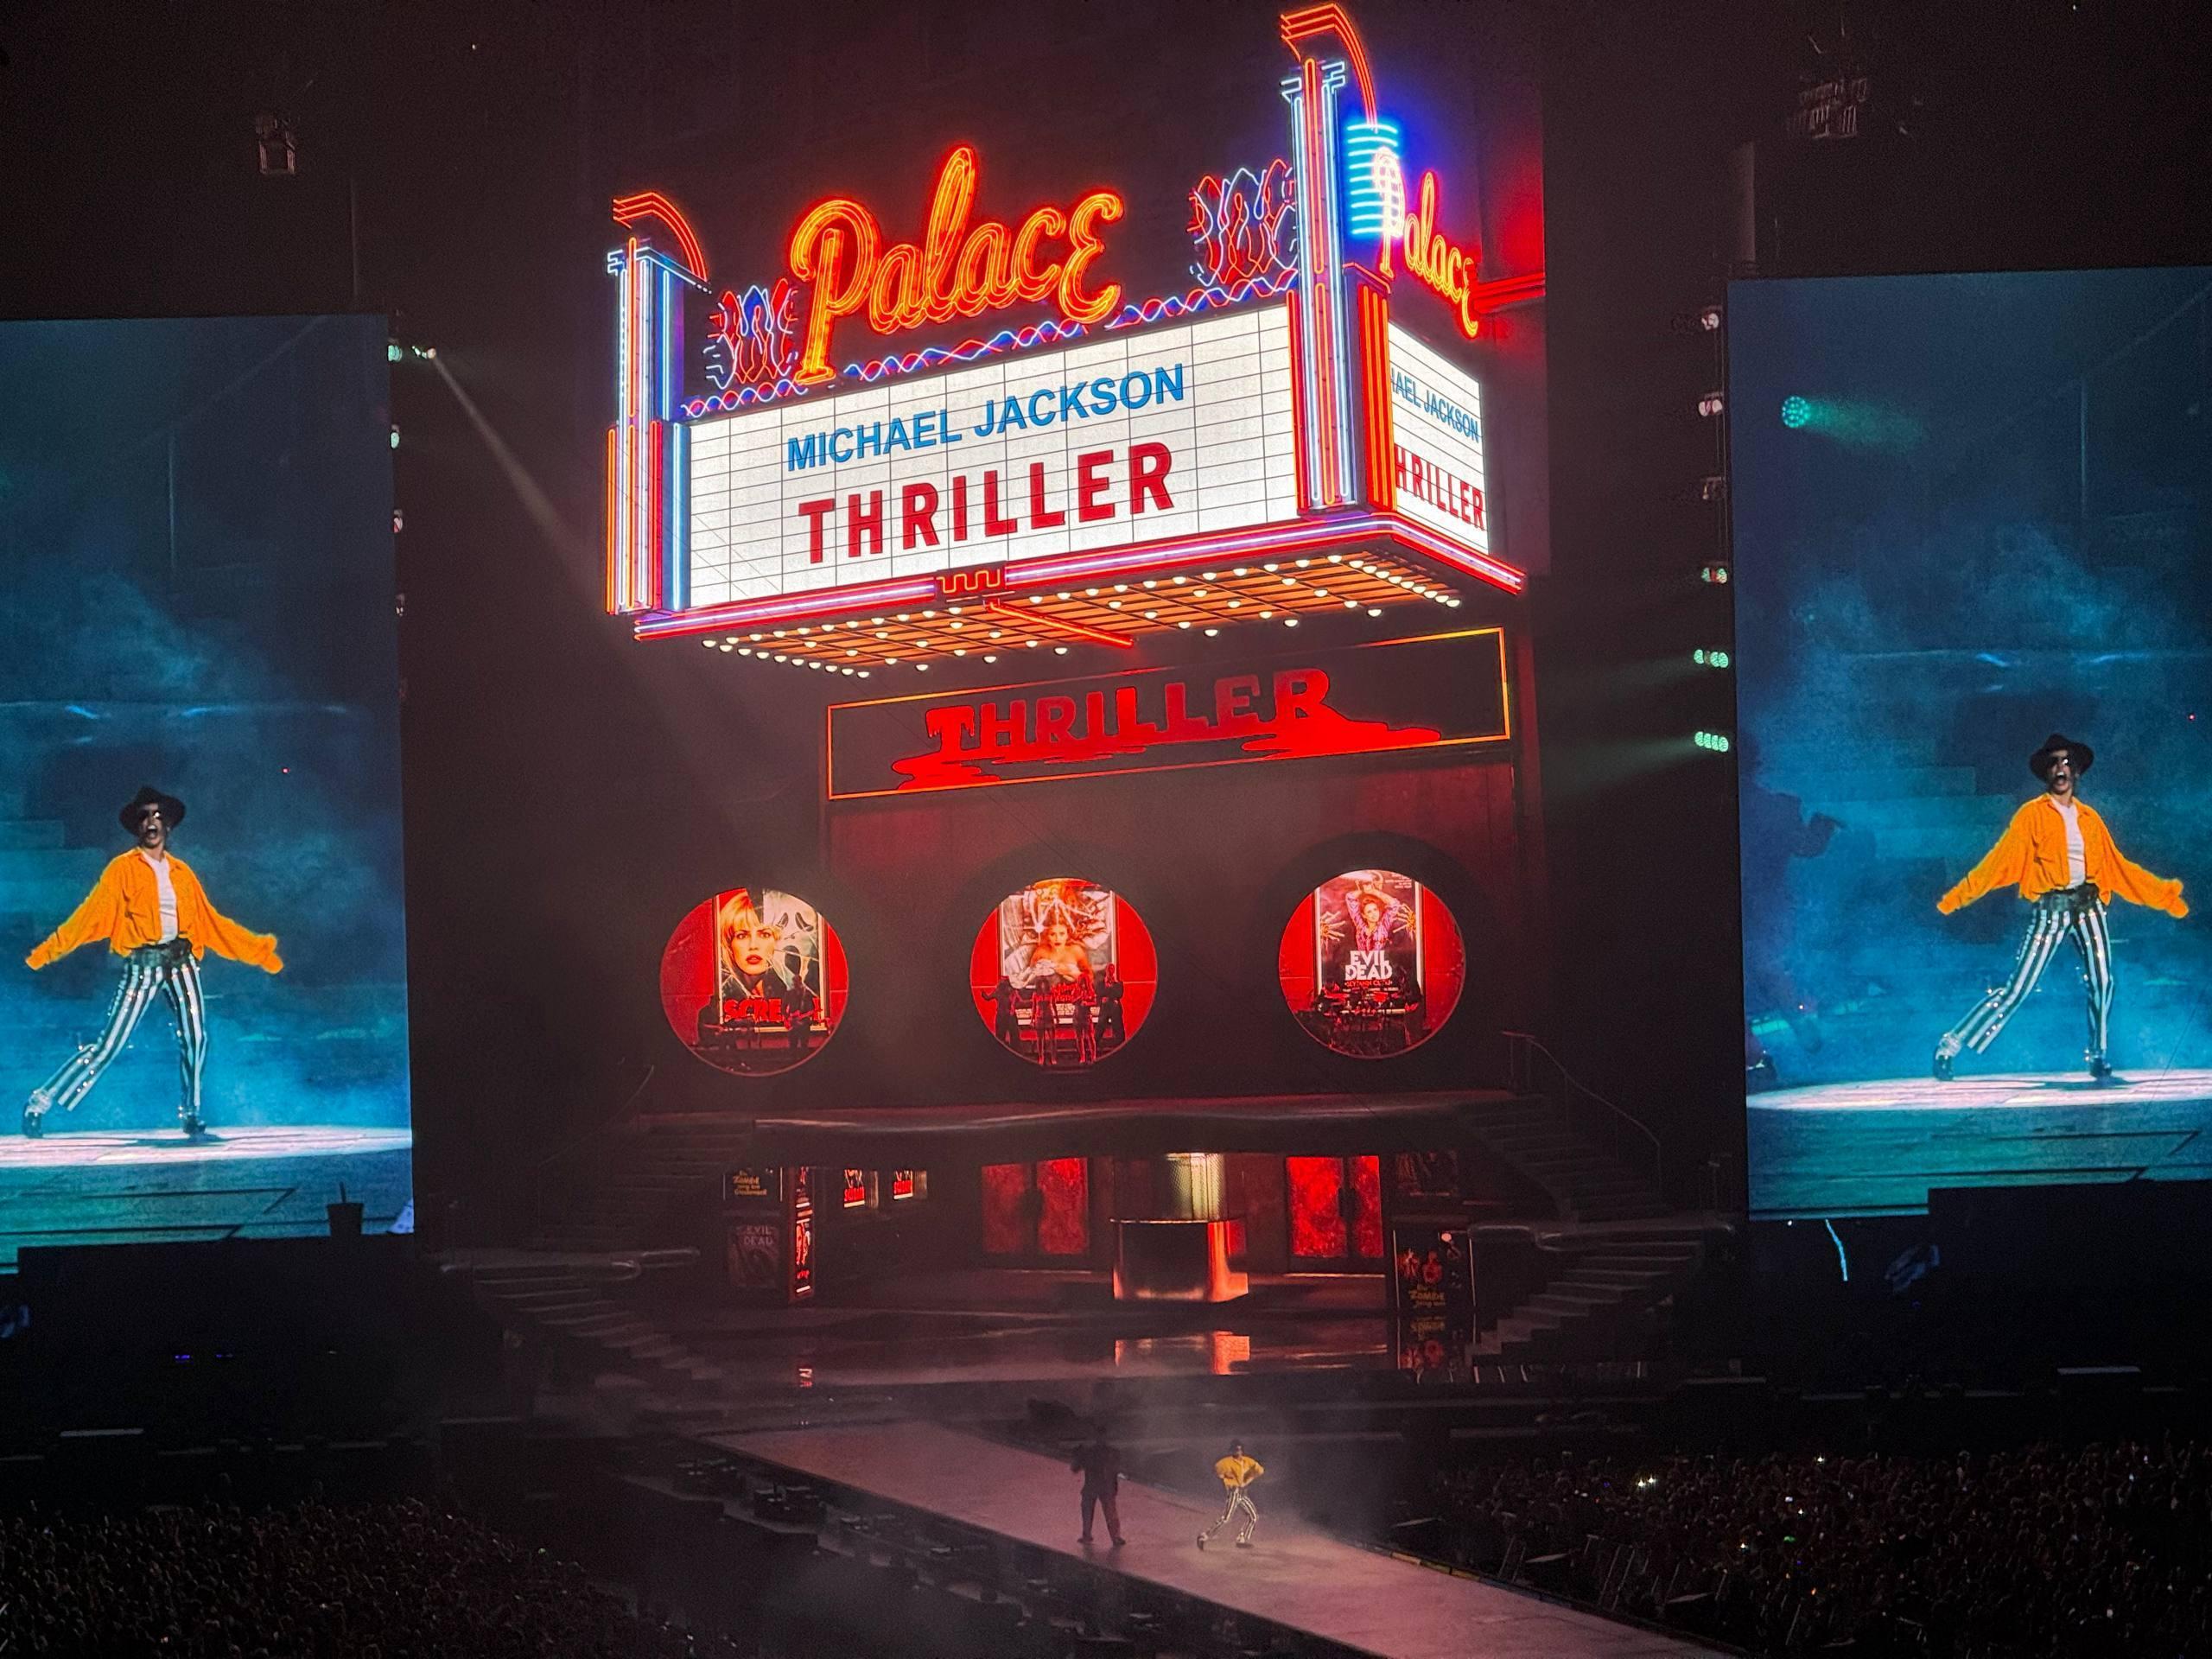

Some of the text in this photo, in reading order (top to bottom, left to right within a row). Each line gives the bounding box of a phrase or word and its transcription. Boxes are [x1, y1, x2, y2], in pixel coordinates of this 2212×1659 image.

[790, 147, 1125, 385] Palace
[1372, 147, 1479, 338] Palace
[787, 363, 1185, 472] MICHAEL JACKSON
[1424, 389, 1479, 443] JACKSON
[798, 442, 1173, 564] THRILLER
[923, 669, 1335, 760] THRILLER
[1344, 964, 1393, 981] DEAD
[1350, 950, 1389, 966] EVIL
[723, 997, 822, 1023] SCRE
